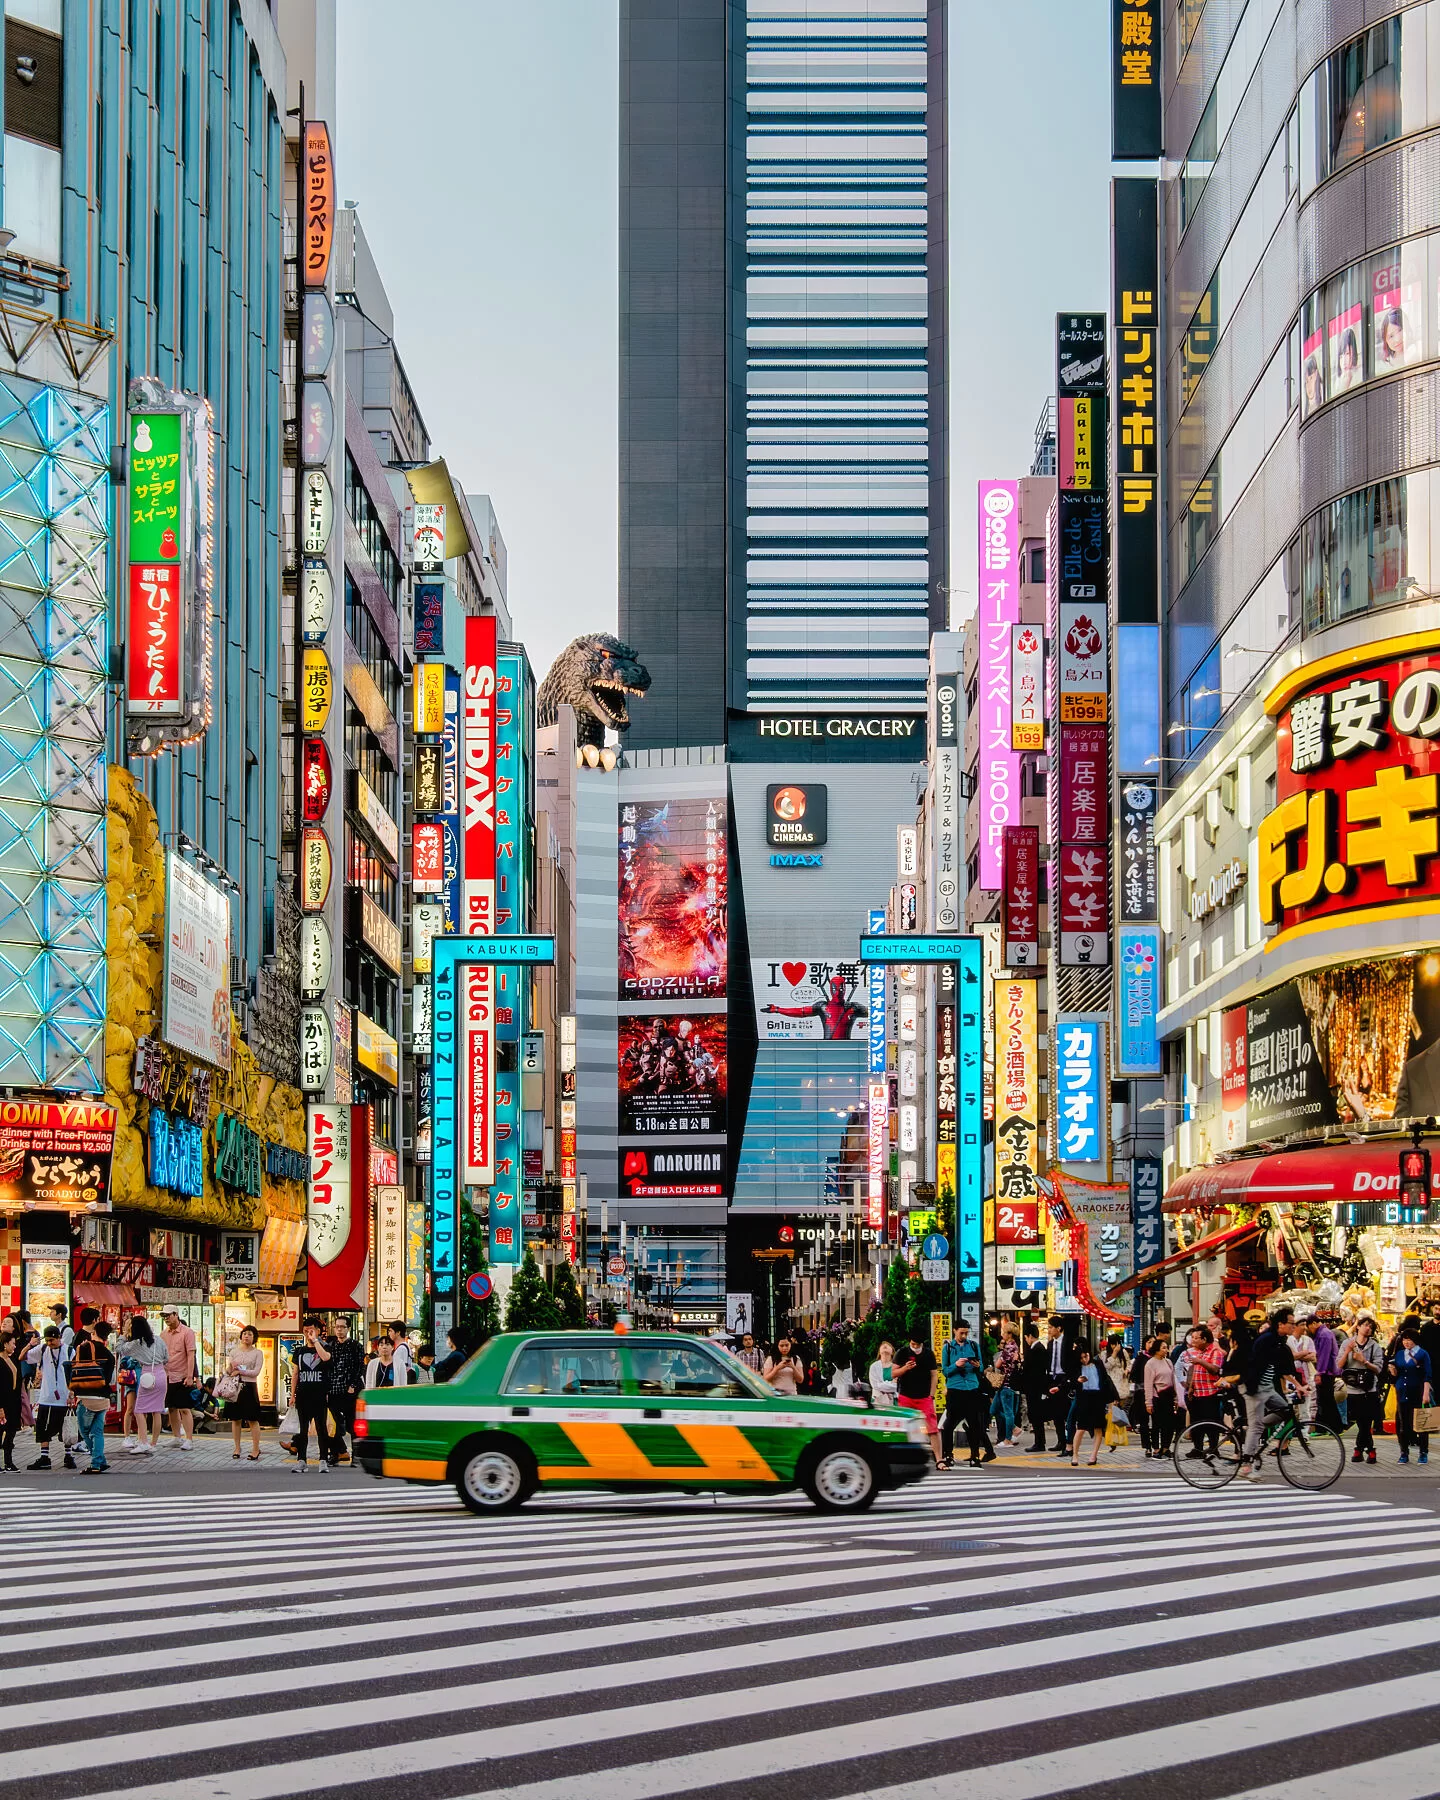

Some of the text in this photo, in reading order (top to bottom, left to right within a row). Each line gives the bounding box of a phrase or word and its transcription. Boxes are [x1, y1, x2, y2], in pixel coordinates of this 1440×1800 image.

[1121, 0, 1152, 84] 殿堂
[308, 140, 325, 150] 新宿
[1085, 319, 1092, 328] 6
[1074, 402, 1090, 470] Garam
[152, 473, 160, 481] と
[135, 480, 176, 499] サラダ
[1062, 494, 1104, 504] New Club
[152, 498, 160, 506] と
[133, 506, 178, 523] スイーツ
[305, 539, 324, 551] 6F
[1084, 507, 1102, 563] Castle
[1064, 517, 1082, 580] Elle de
[141, 568, 169, 582] 新宿
[422, 562, 435, 571] 8F
[1072, 586, 1094, 596] 7F
[139, 582, 171, 697] ひょうたん
[308, 632, 321, 640] 5F
[987, 579, 1012, 750] オープンスペース
[1064, 668, 1103, 681] 鳥メロ
[306, 671, 328, 713] 虎の子
[1020, 675, 1036, 720] 鳥メロ
[1064, 696, 1103, 706] 生ビール
[147, 702, 164, 710] 7F
[937, 685, 956, 737] Booth
[305, 720, 320, 728] 4F
[759, 719, 916, 736] HOTEL GRACERY
[465, 665, 495, 832] SHIDAX
[1018, 733, 1041, 744] 199
[1069, 742, 1099, 752] 居酒屋
[419, 747, 437, 801] 山内農場
[1072, 761, 1096, 840] 居楽屋
[942, 754, 952, 872] ネットカフェ & カプセル
[773, 824, 802, 832] TOHO
[773, 833, 814, 841] CINEMAS
[415, 839, 428, 877] さかい
[427, 837, 440, 868] 焼肉屋
[622, 805, 637, 890] 起動する。
[309, 842, 322, 901] お好み焼き
[769, 854, 823, 867] IMAX
[1016, 848, 1029, 884] 居楽屋
[1124, 812, 1143, 914] かんかん商店
[421, 882, 434, 891] 4F
[1191, 859, 1247, 922] Don Quijote
[866, 944, 962, 954] CENTRAL ROAD
[624, 976, 720, 989] GODZILLA
[767, 963, 780, 987] I
[305, 990, 321, 999] 1F
[1128, 978, 1140, 1027] STAGE
[1140, 979, 1152, 1017] IDOL
[304, 1013, 323, 1022] 新宿
[871, 968, 885, 1066] カラオケランド
[304, 1022, 323, 1069] かっぱ
[1006, 985, 1026, 1088] きんくら酒場
[1224, 1036, 1245, 1071] 免税
[306, 1074, 321, 1084] B1
[1063, 1027, 1095, 1154] カラオケ
[473, 1034, 484, 1162] BIC CAMERA SHIDAX
[57, 1104, 115, 1128] YAKI
[436, 990, 453, 1243] GODZILLA ROAD
[939, 1120, 956, 1129] 4F
[963, 1012, 979, 1225] ゴジラロード
[0, 1138, 112, 1153] Drinks for 2 hours ¥2,500
[33, 1128, 113, 1142] with Free-Flowing
[335, 1108, 348, 1161] 大衆酒場
[939, 1131, 956, 1140] 3F
[312, 1113, 334, 1204] トラノコ
[495, 1089, 513, 1245] カラオケ館
[653, 1154, 721, 1171] MARUHAN
[998, 1115, 1036, 1199] 金の蔵
[30, 1156, 101, 1186] とらぢゅう
[1353, 1171, 1400, 1192] Don
[35, 1189, 81, 1199] TORADYU
[84, 1190, 96, 1198] 2F
[329, 1204, 345, 1243] やきとり
[999, 1206, 1024, 1228] 2F
[1137, 1163, 1158, 1263] カラオケ
[261, 1310, 297, 1319] トラノコ
